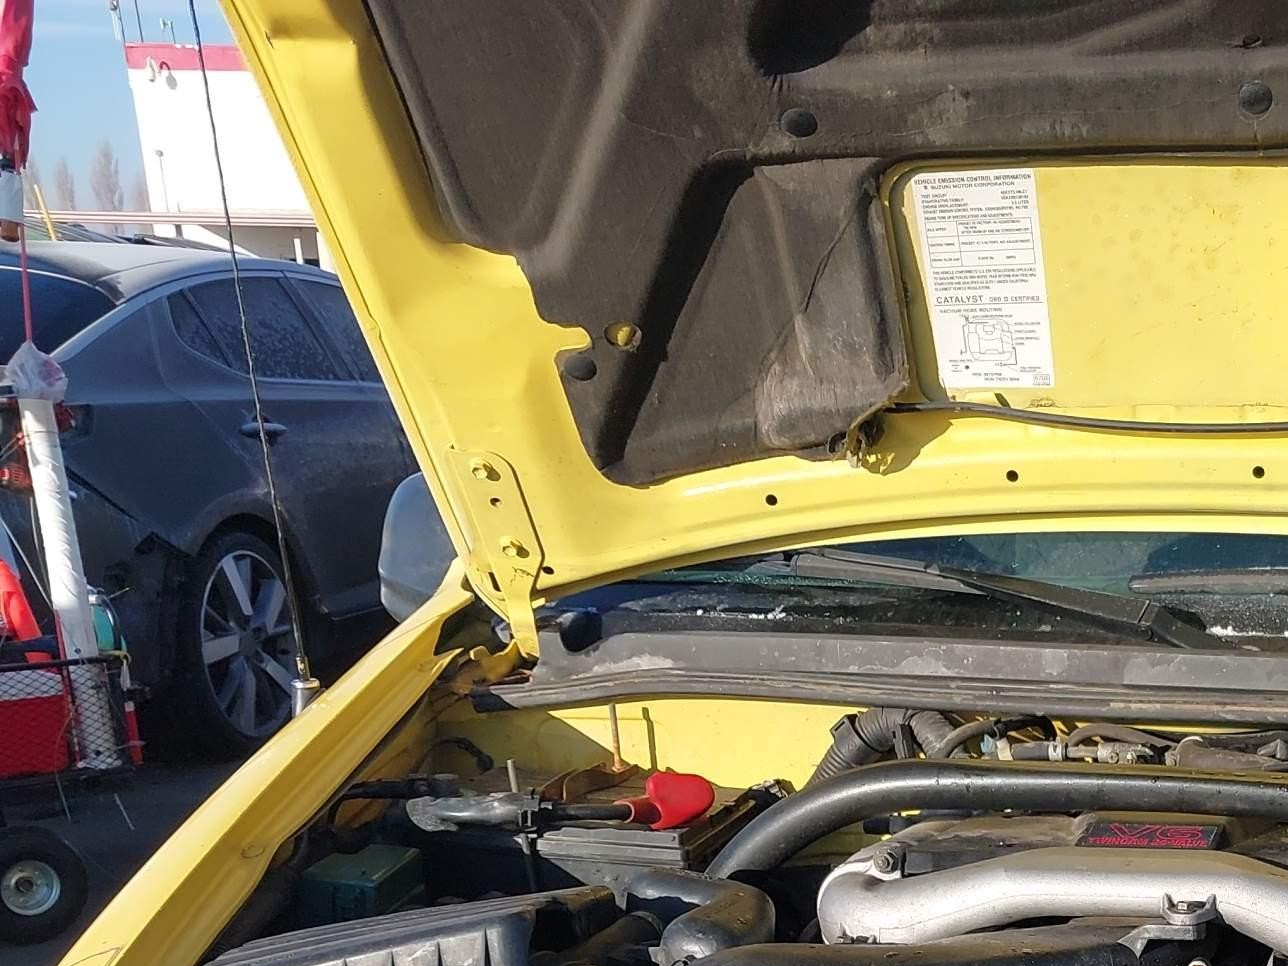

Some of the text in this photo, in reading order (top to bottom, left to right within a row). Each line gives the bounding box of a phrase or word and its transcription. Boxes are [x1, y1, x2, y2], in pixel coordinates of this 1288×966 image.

[913, 173, 1032, 186] VEHICLE EMISSION CONTROL INFORMATION
[936, 295, 983, 305] CATALYST
[1109, 822, 1205, 840] V6
[1087, 837, 1148, 846] TWINCAM
